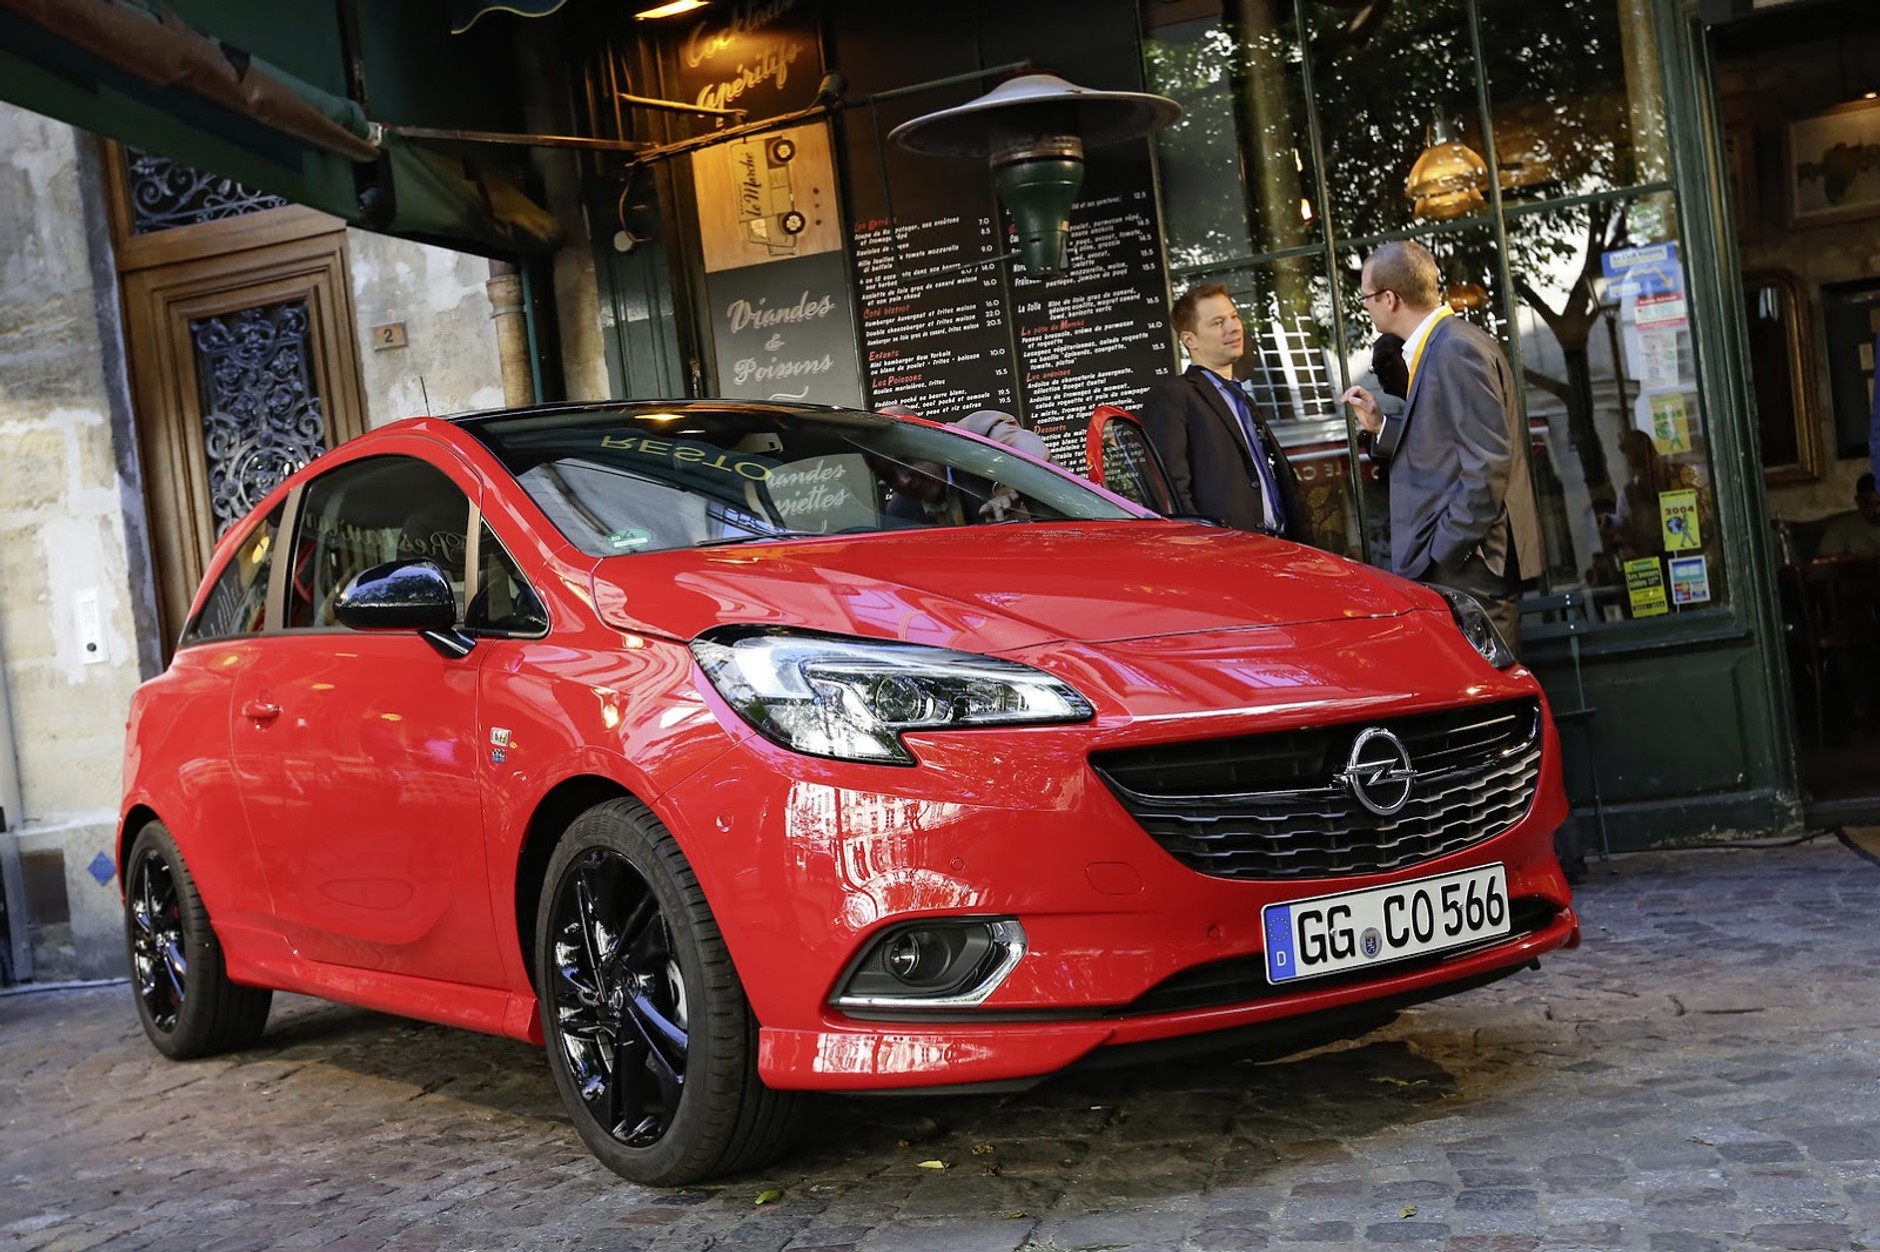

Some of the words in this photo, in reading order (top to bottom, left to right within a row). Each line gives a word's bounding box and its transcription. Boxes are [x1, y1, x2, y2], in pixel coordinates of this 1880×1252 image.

[739, 152, 762, 203] Marché
[727, 290, 836, 334] Viandes
[384, 328, 394, 343] 2
[765, 333, 785, 351] &
[990, 348, 1005, 356] 10.0
[734, 354, 834, 385] Poissons
[1297, 904, 1357, 966] GG
[1383, 889, 1436, 949] CO
[1440, 875, 1506, 937] 566
[1276, 951, 1287, 968] D
